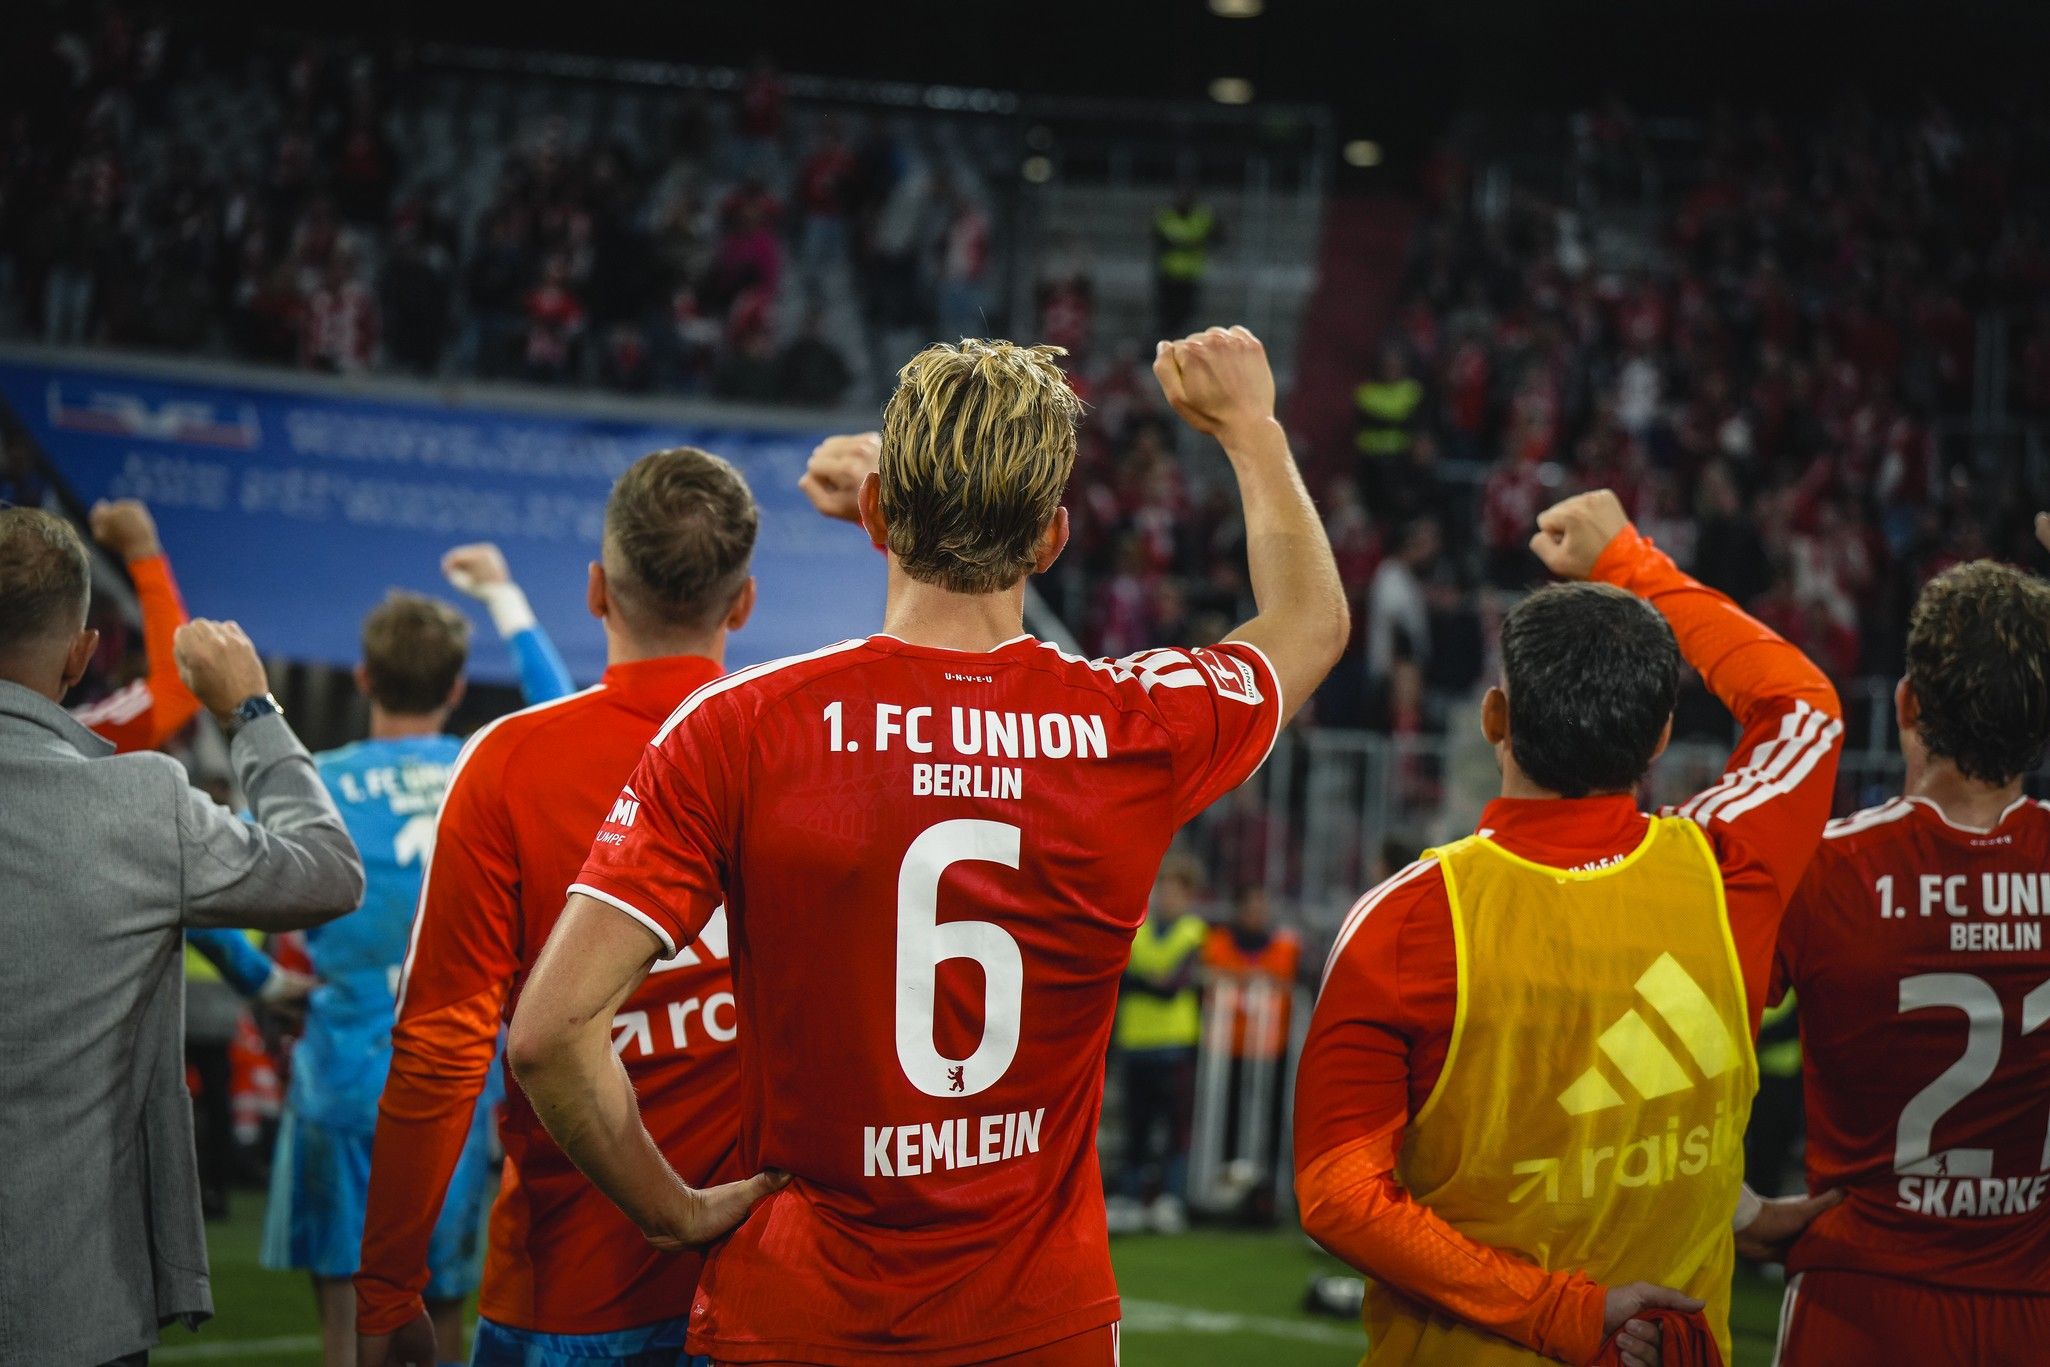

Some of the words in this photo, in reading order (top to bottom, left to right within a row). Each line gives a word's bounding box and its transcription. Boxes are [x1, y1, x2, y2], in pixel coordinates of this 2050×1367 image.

[823, 701, 858, 753] 1.
[875, 704, 933, 753] FC
[951, 706, 1108, 759] UNION
[913, 763, 1022, 799] BERLIN
[1875, 874, 1905, 919] 1.
[1919, 874, 1968, 917] FC
[895, 818, 1023, 1098] 6
[1950, 922, 2042, 951] BERLIN
[864, 1107, 1045, 1177] KEMLEIN
[1896, 1174, 2050, 1218] SKARKE
